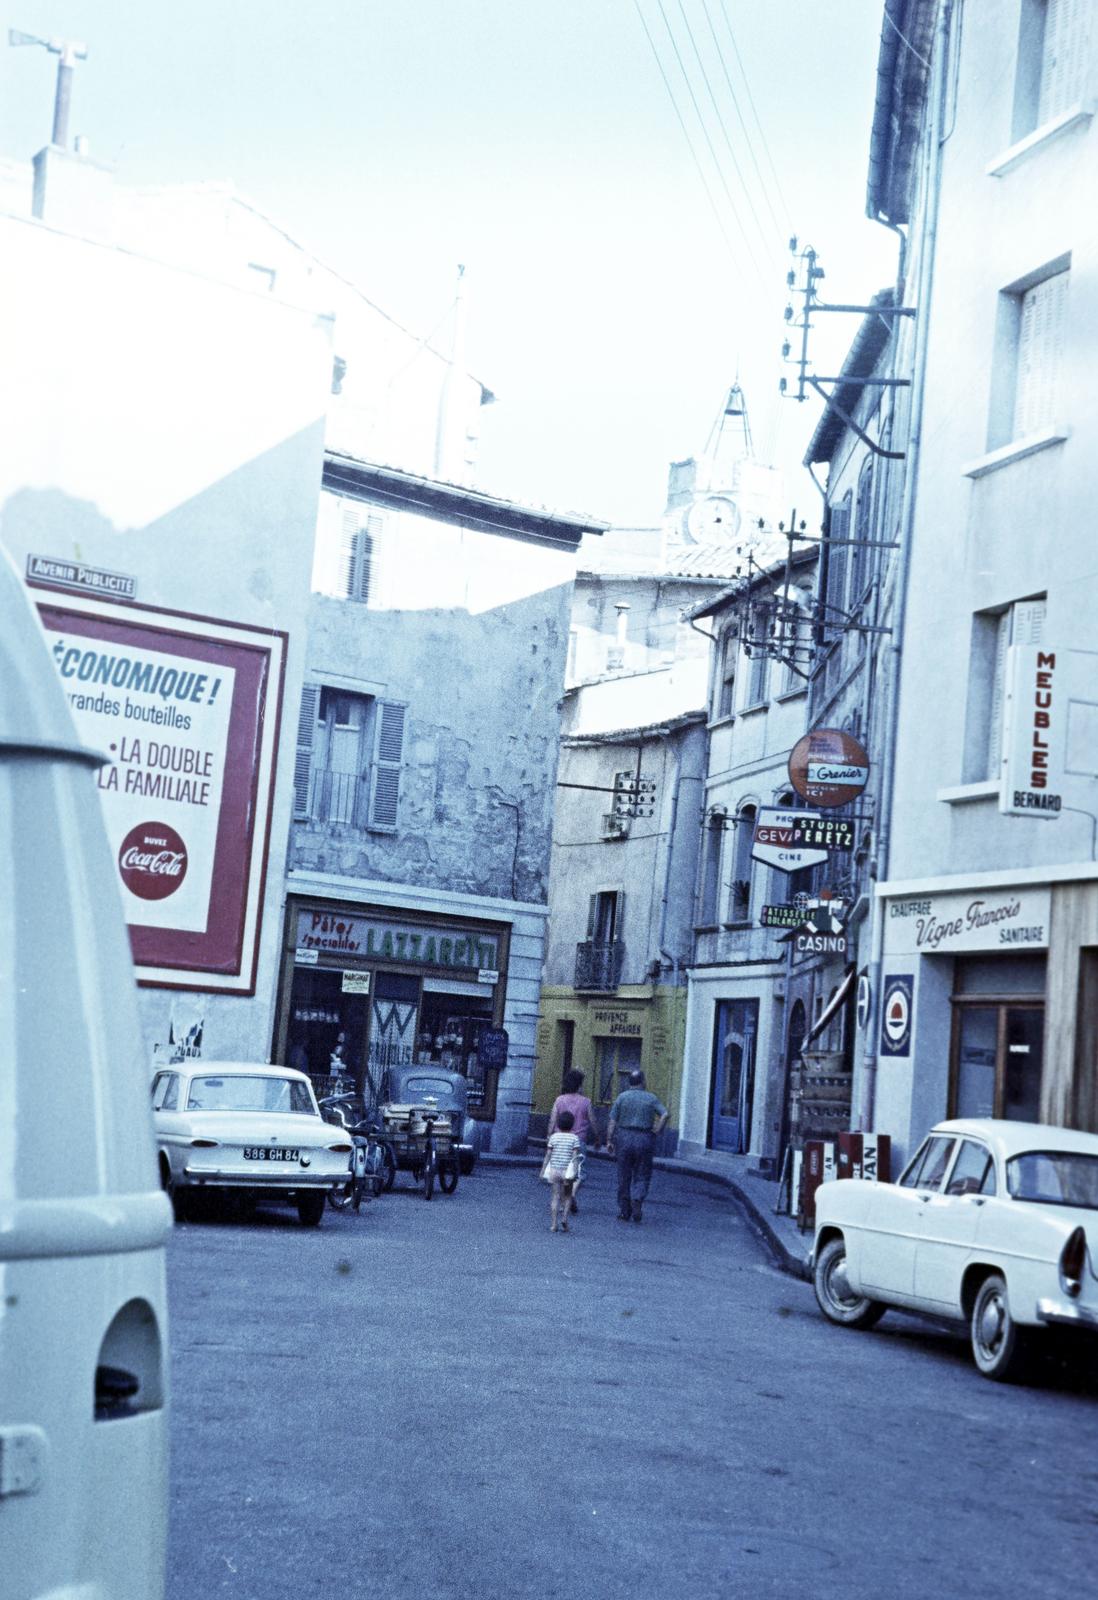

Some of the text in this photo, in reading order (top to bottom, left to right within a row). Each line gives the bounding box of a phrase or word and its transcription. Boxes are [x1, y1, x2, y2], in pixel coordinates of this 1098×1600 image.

[34, 559, 133, 593] AVENIR PUBLICITÉ
[67, 691, 192, 731] randes bouteilles
[1030, 651, 1056, 789] MEUBLES
[120, 736, 214, 778] LA DOUBLE
[97, 765, 211, 807] LA FAMILIALE
[1013, 790, 1062, 812] BERNARD
[800, 820, 848, 832] STUDIO
[121, 846, 186, 876] Coca-Cola
[890, 901, 932, 918] CHAUFFAGE
[916, 898, 1021, 948] Vigne François
[797, 935, 846, 952] CASINO
[1000, 926, 1044, 943] SANITAIRE
[244, 1148, 298, 1161] 386 GH 84
